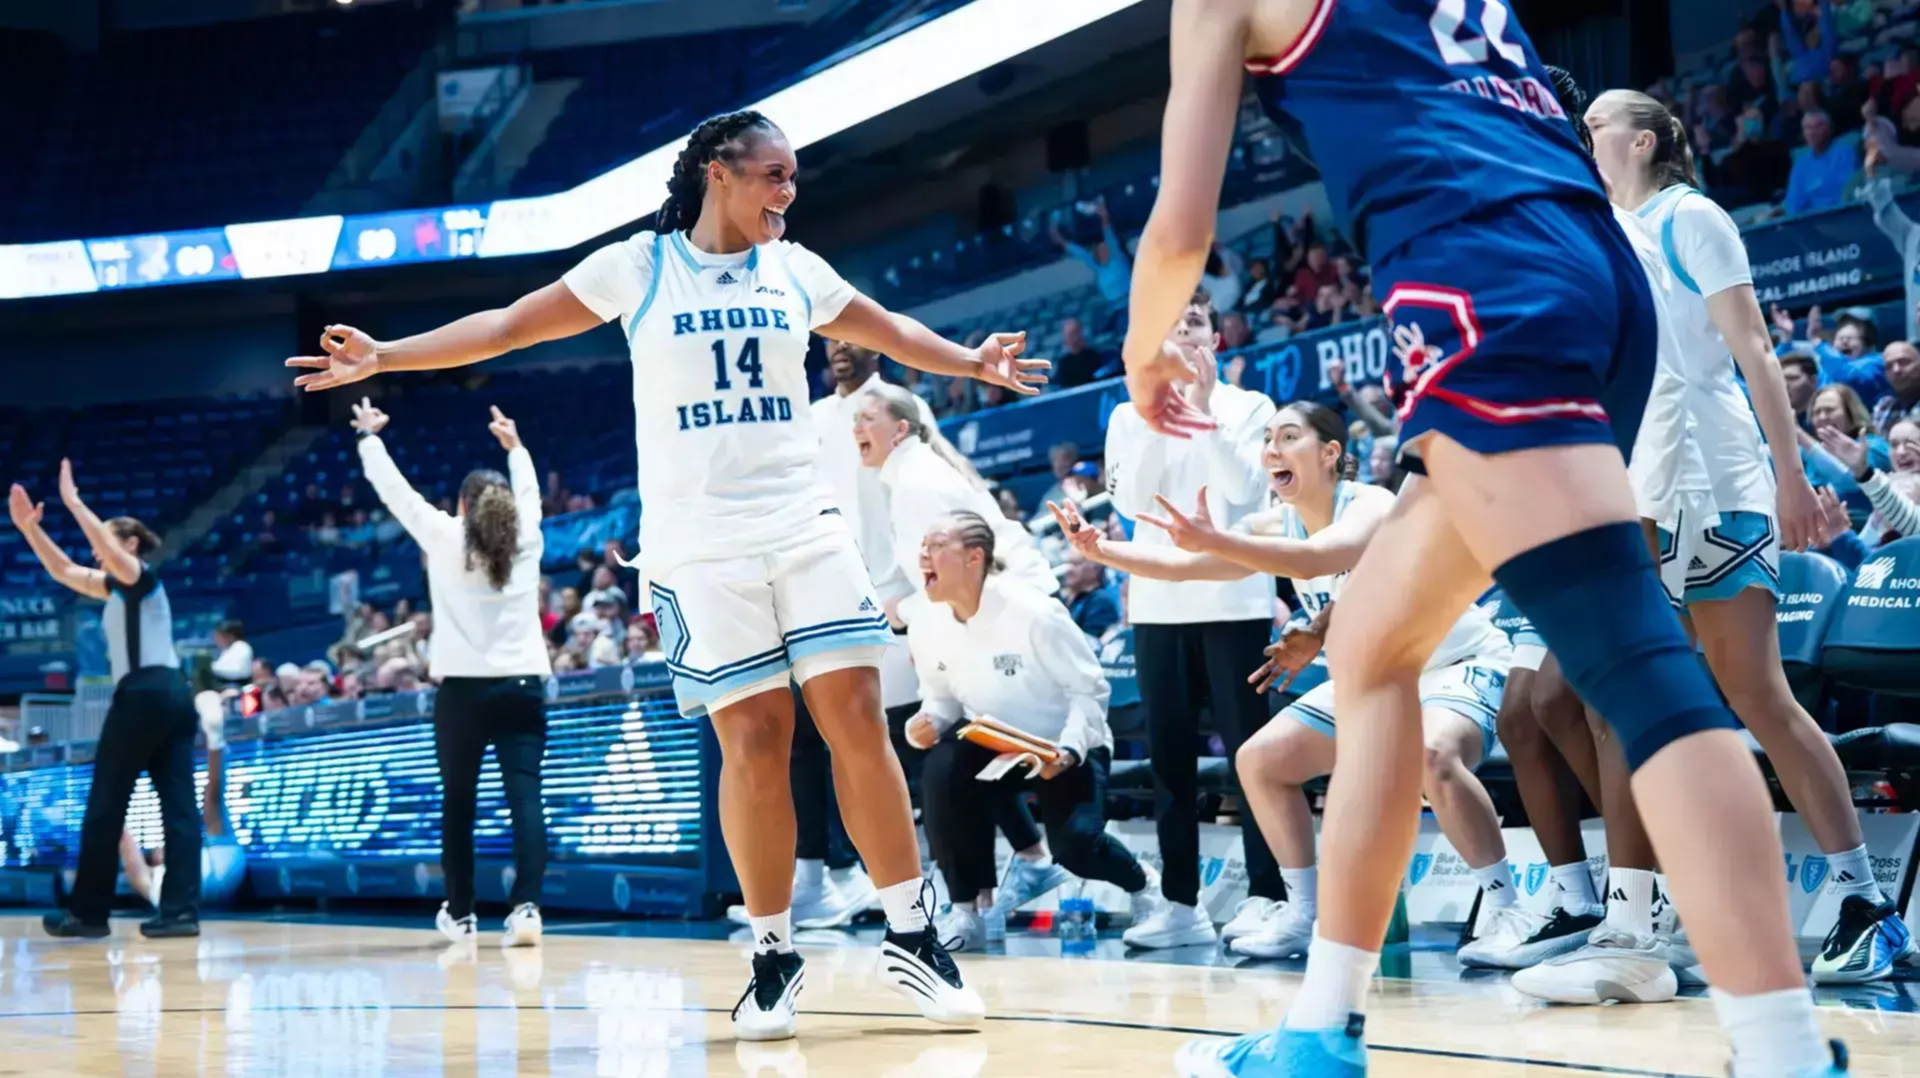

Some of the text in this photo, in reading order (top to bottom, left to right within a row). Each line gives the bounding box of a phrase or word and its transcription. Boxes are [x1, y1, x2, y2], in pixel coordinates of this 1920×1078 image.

[1804, 243, 1860, 267] ISLAND
[1787, 268, 1861, 297] IMAGING
[672, 307, 790, 336] RHODE
[711, 336, 764, 391] 14
[676, 396, 793, 431] ISLAND
[1786, 592, 1824, 605] ISLAND
[1847, 595, 1912, 608] MEDICAL
